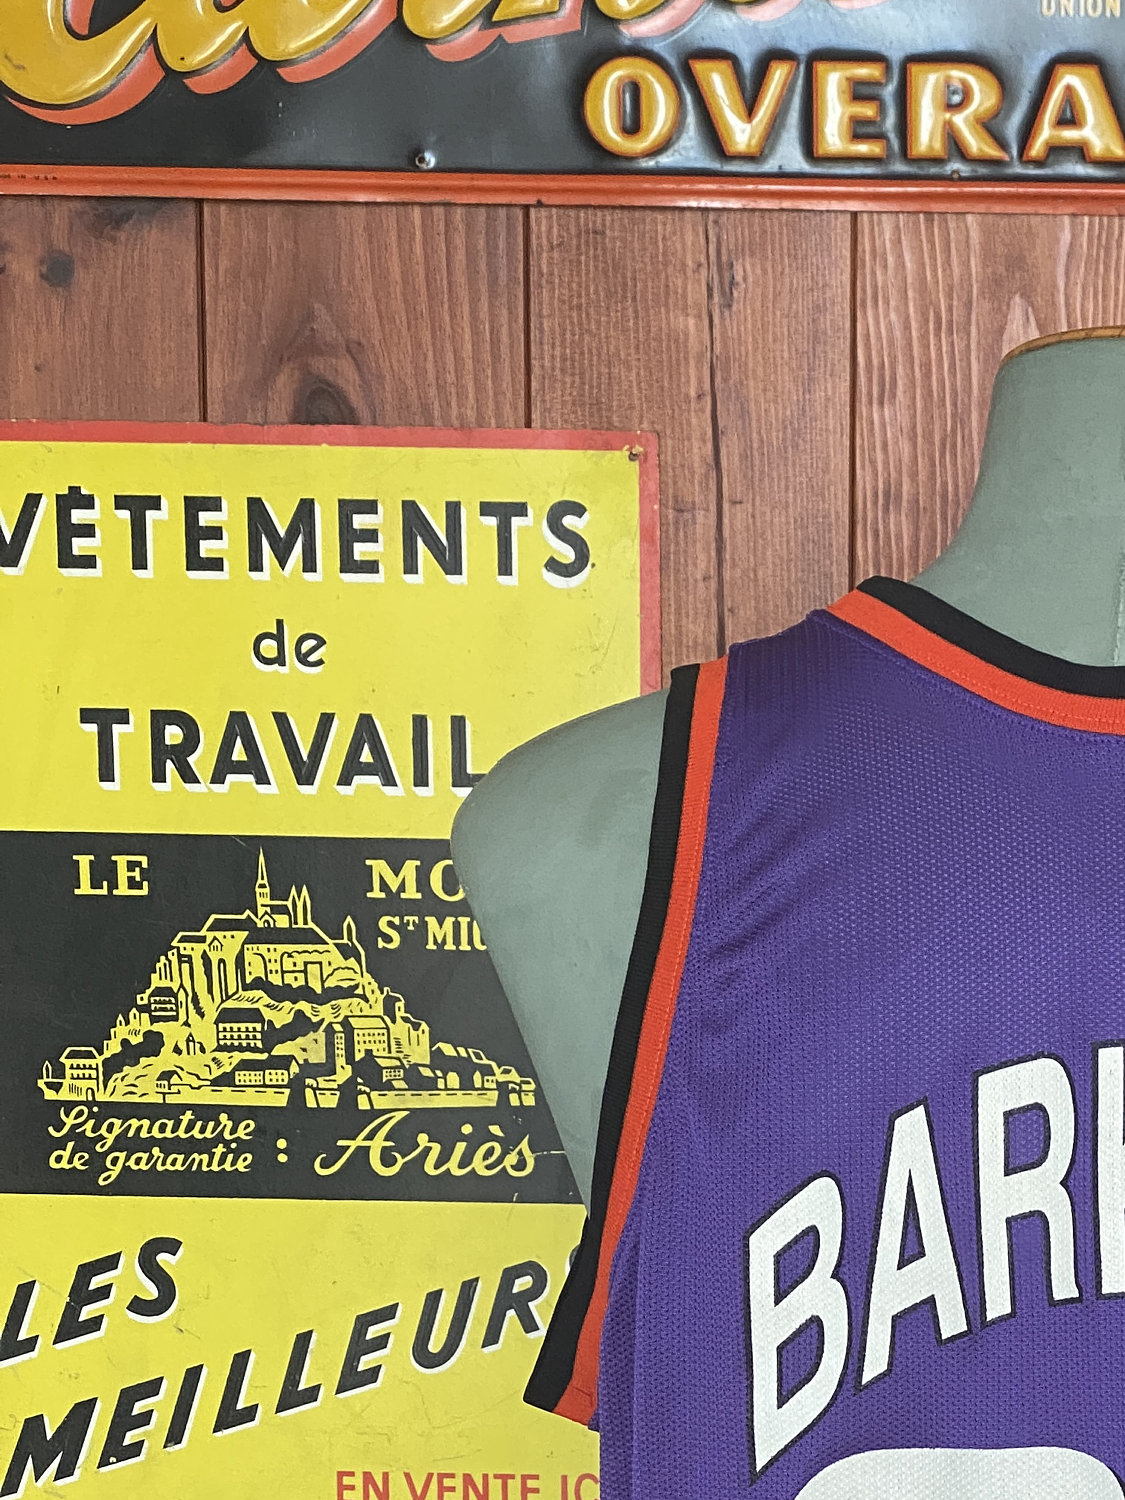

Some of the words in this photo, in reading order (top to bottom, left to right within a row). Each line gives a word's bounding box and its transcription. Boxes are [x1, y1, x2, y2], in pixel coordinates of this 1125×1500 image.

[1041, 0, 1121, 18] UNION
[252, 619, 327, 673] de
[79, 708, 488, 796] TRAVAIL
[72, 855, 149, 895] LE
[47, 1105, 256, 1152] Signature
[314, 1110, 536, 1178] Ariès
[49, 1145, 89, 1171] de
[97, 1143, 255, 1186] garantie
[0, 1236, 183, 1368] LES
